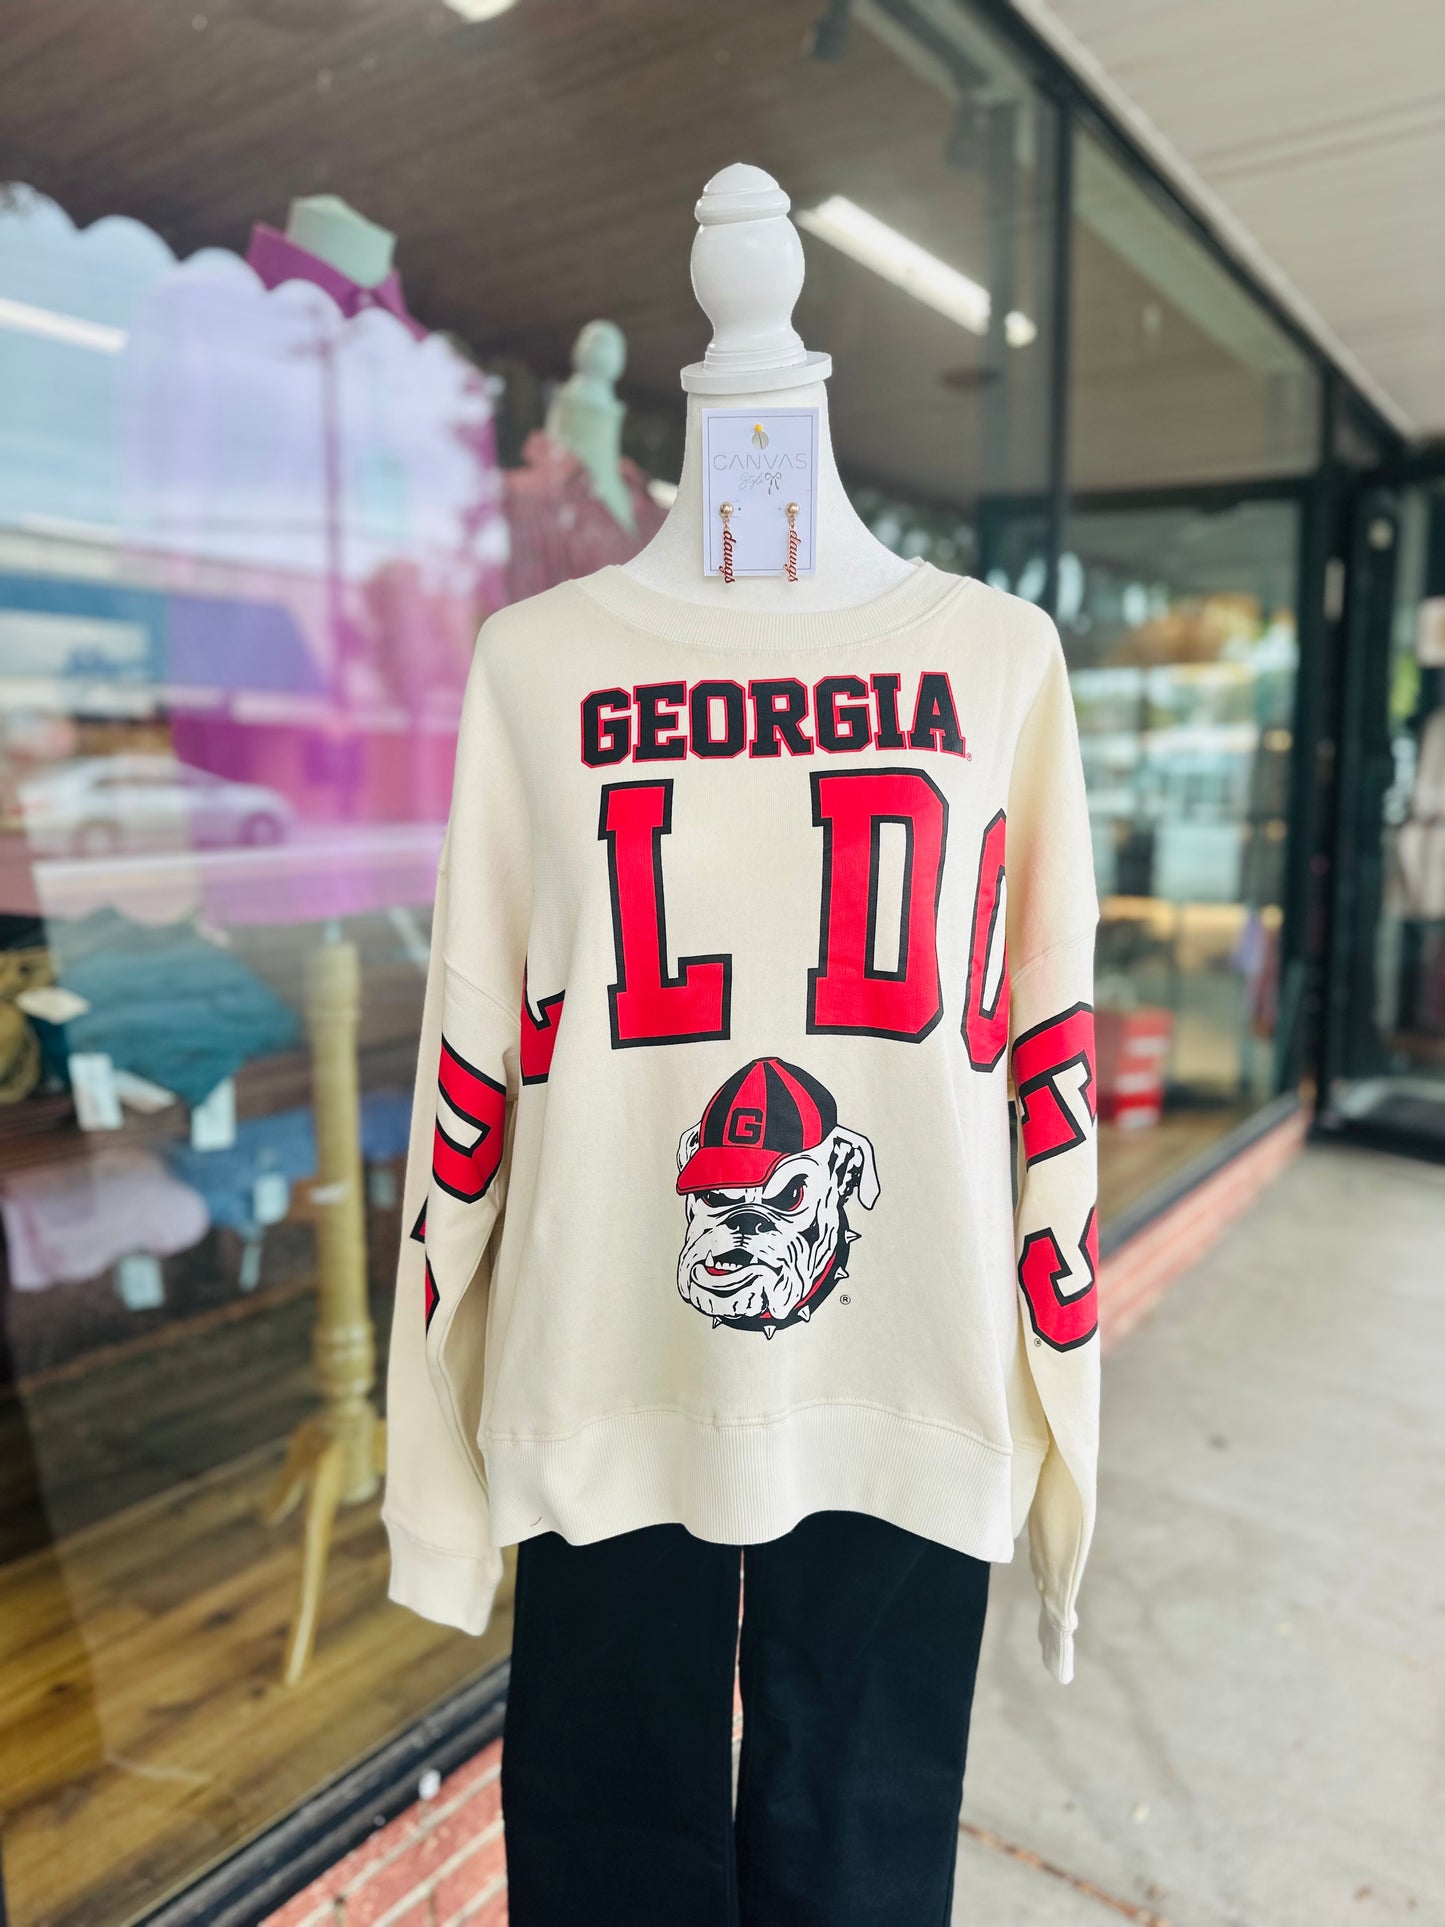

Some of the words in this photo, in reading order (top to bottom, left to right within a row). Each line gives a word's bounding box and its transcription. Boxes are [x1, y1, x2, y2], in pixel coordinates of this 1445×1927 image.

[713, 453, 808, 471] CANVAS
[719, 530, 737, 584] dawgs
[783, 529, 802, 583] dawgs
[580, 671, 967, 768] GEORGIA
[727, 1107, 764, 1143] G
